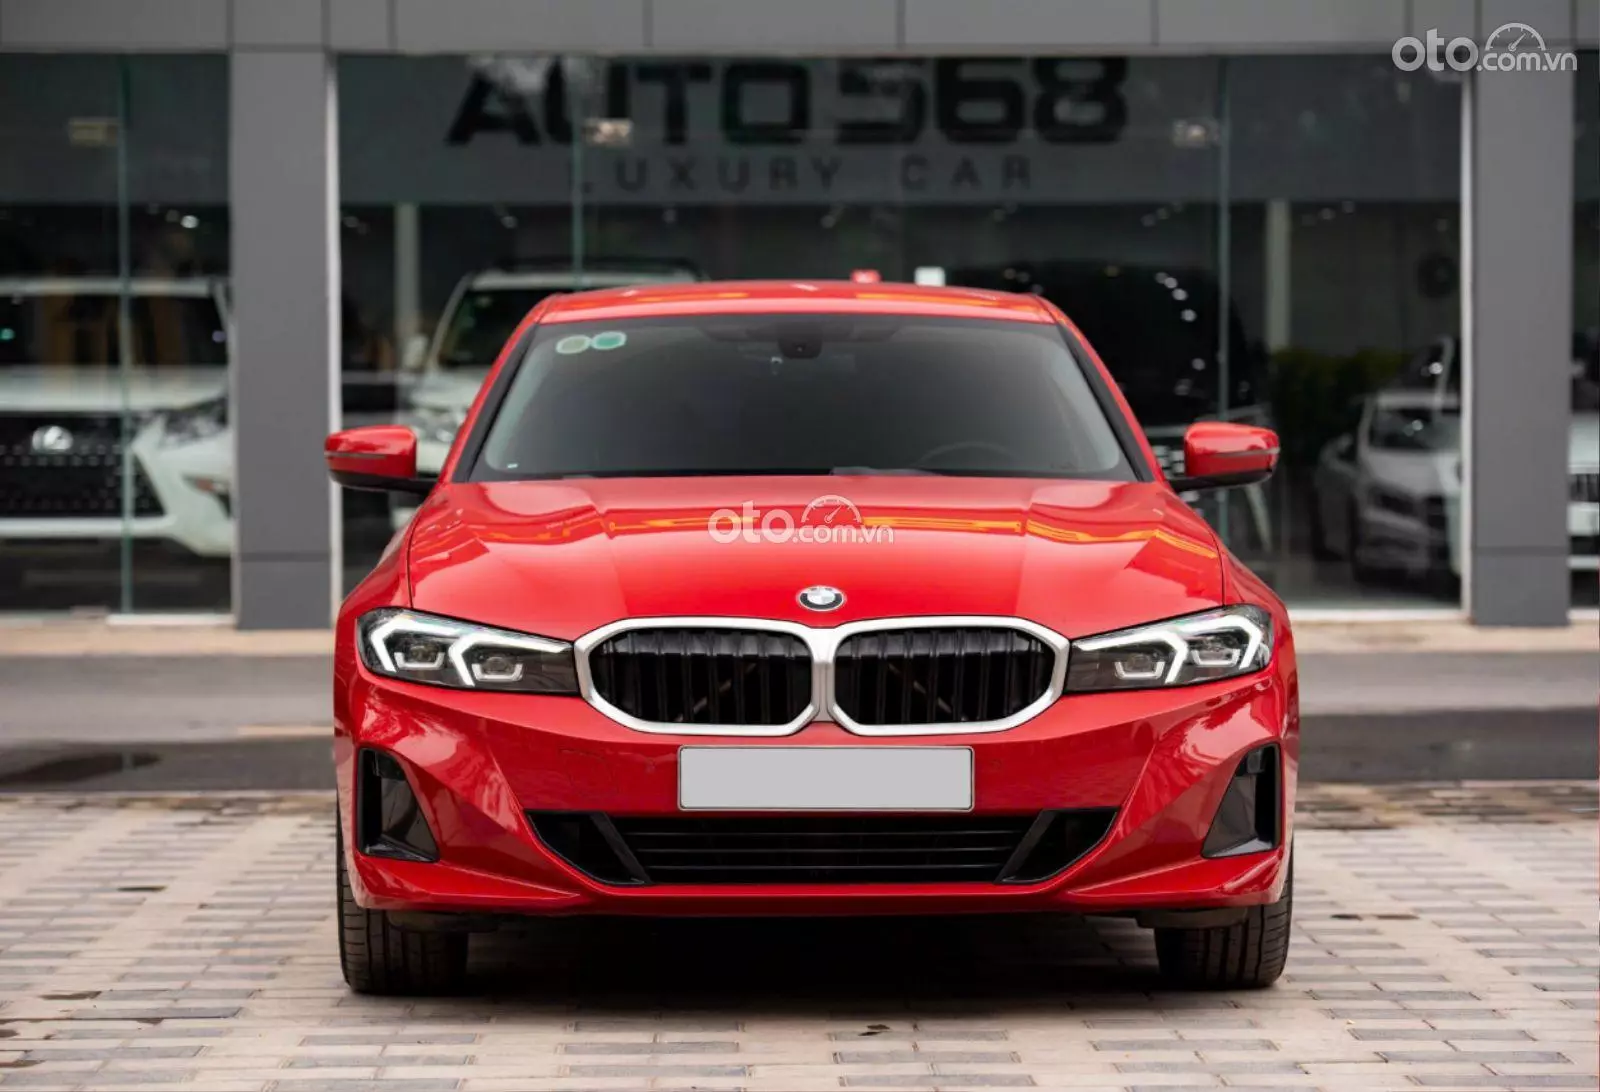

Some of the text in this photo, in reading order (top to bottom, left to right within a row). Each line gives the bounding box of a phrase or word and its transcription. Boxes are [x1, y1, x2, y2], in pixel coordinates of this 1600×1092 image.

[445, 55, 1129, 145] AUTO 568
[901, 154, 1032, 192] CAR
